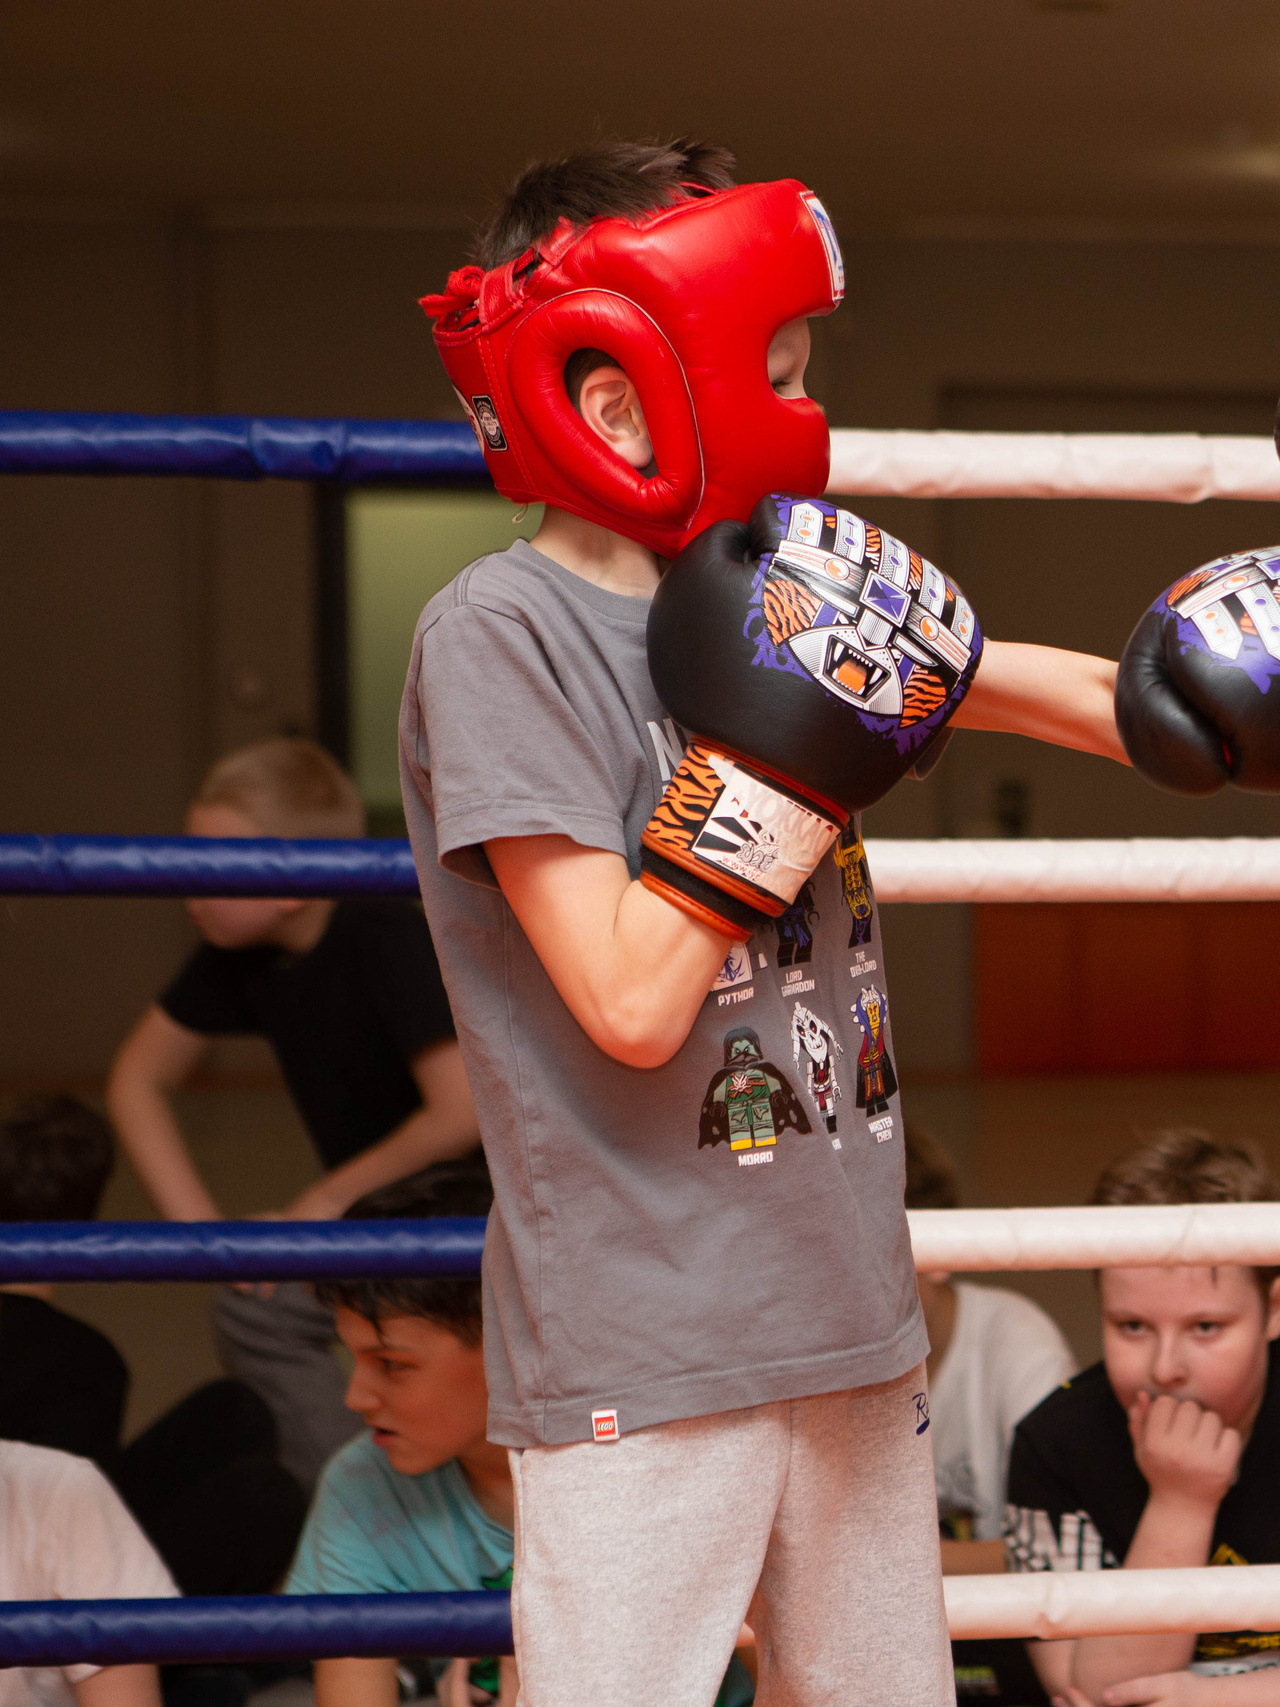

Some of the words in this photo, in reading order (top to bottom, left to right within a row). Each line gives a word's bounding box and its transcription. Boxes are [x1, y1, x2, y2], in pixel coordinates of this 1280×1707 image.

[785, 969, 803, 984] LORD
[717, 986, 755, 1007] PYTHOR
[868, 1116, 894, 1134] MASTER
[737, 1150, 774, 1167] MORRO
[597, 1421, 614, 1432] LEGO
